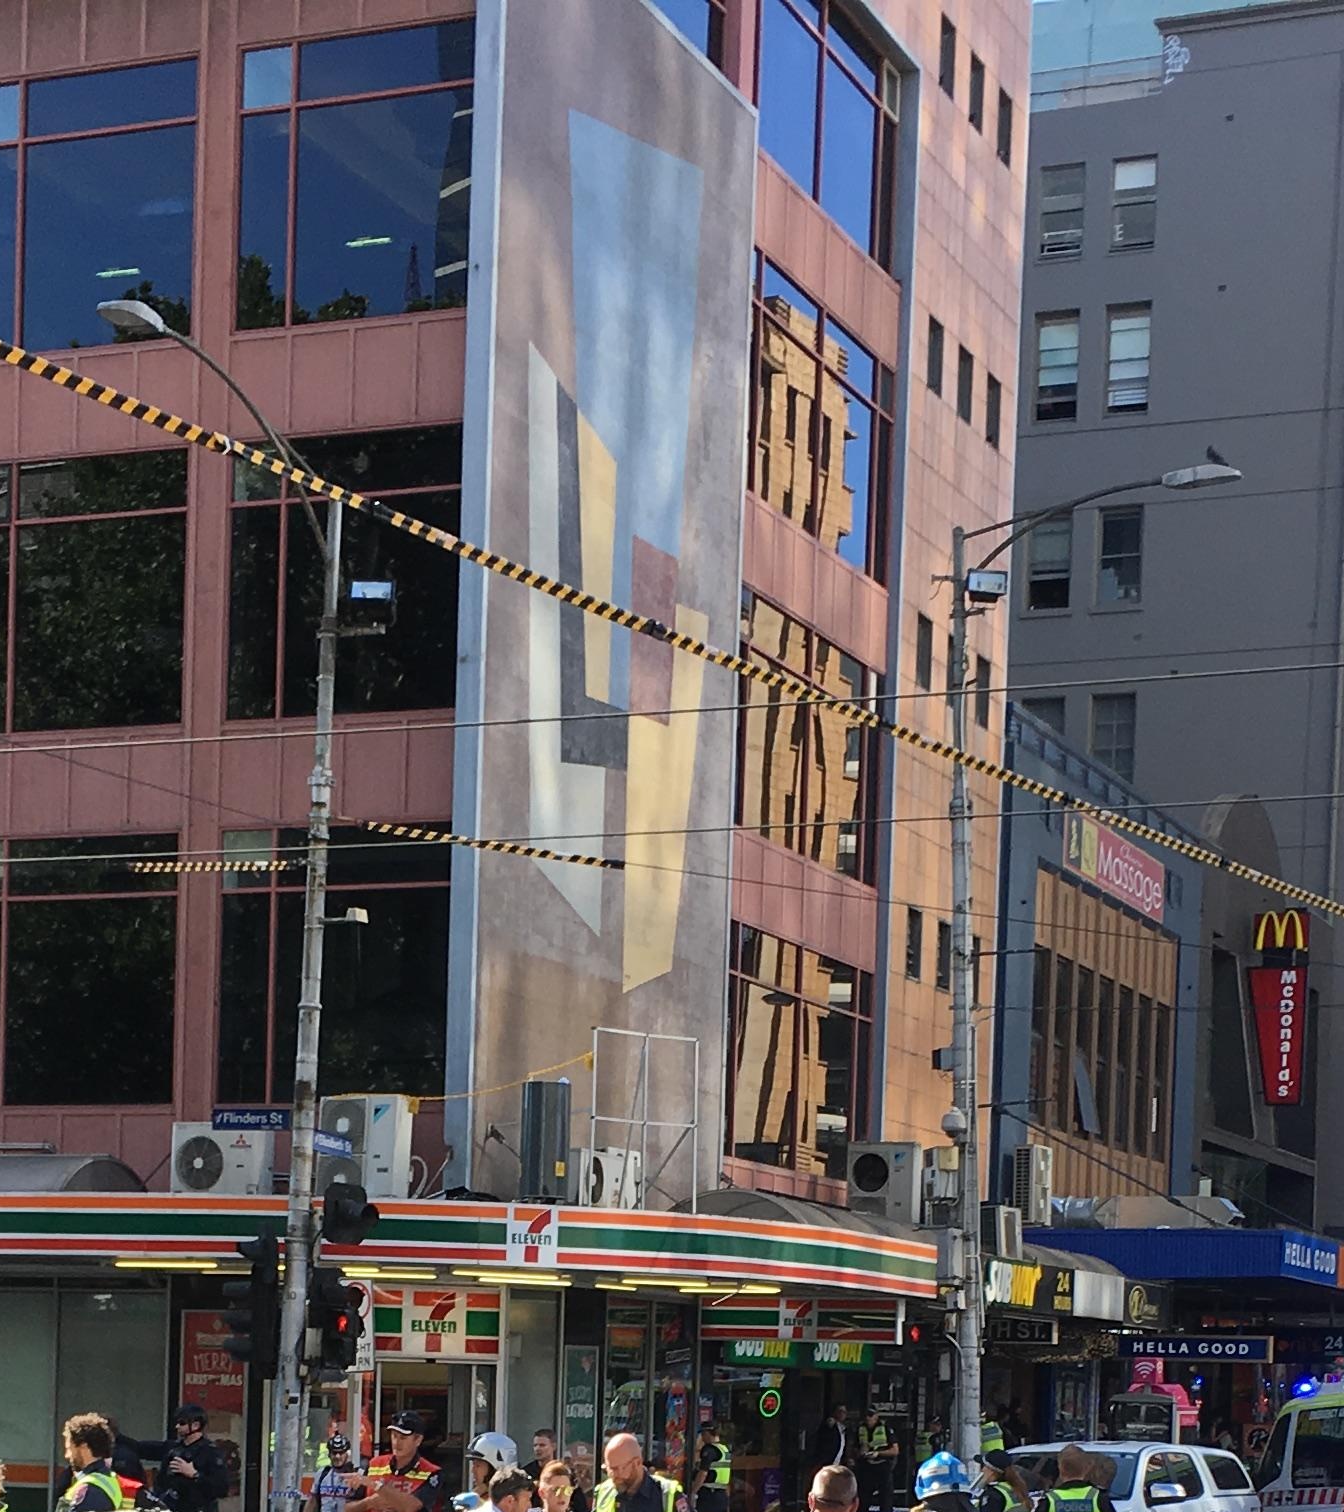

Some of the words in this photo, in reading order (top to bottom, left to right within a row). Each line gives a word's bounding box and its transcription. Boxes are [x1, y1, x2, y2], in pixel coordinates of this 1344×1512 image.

[1098, 840, 1163, 913] Massage
[1279, 970, 1297, 1097] McDonald's
[223, 1112, 268, 1124] Flinders
[269, 1112, 282, 1124] St
[1284, 1241, 1312, 1270] HELLA
[1314, 1249, 1336, 1275] GOOD
[1056, 1271, 1071, 1293] 24
[1133, 1341, 1189, 1354] HELLA
[1197, 1342, 1249, 1355] GOOD
[1324, 1336, 1343, 1350] 24
[1056, 1501, 1092, 1512] Police
